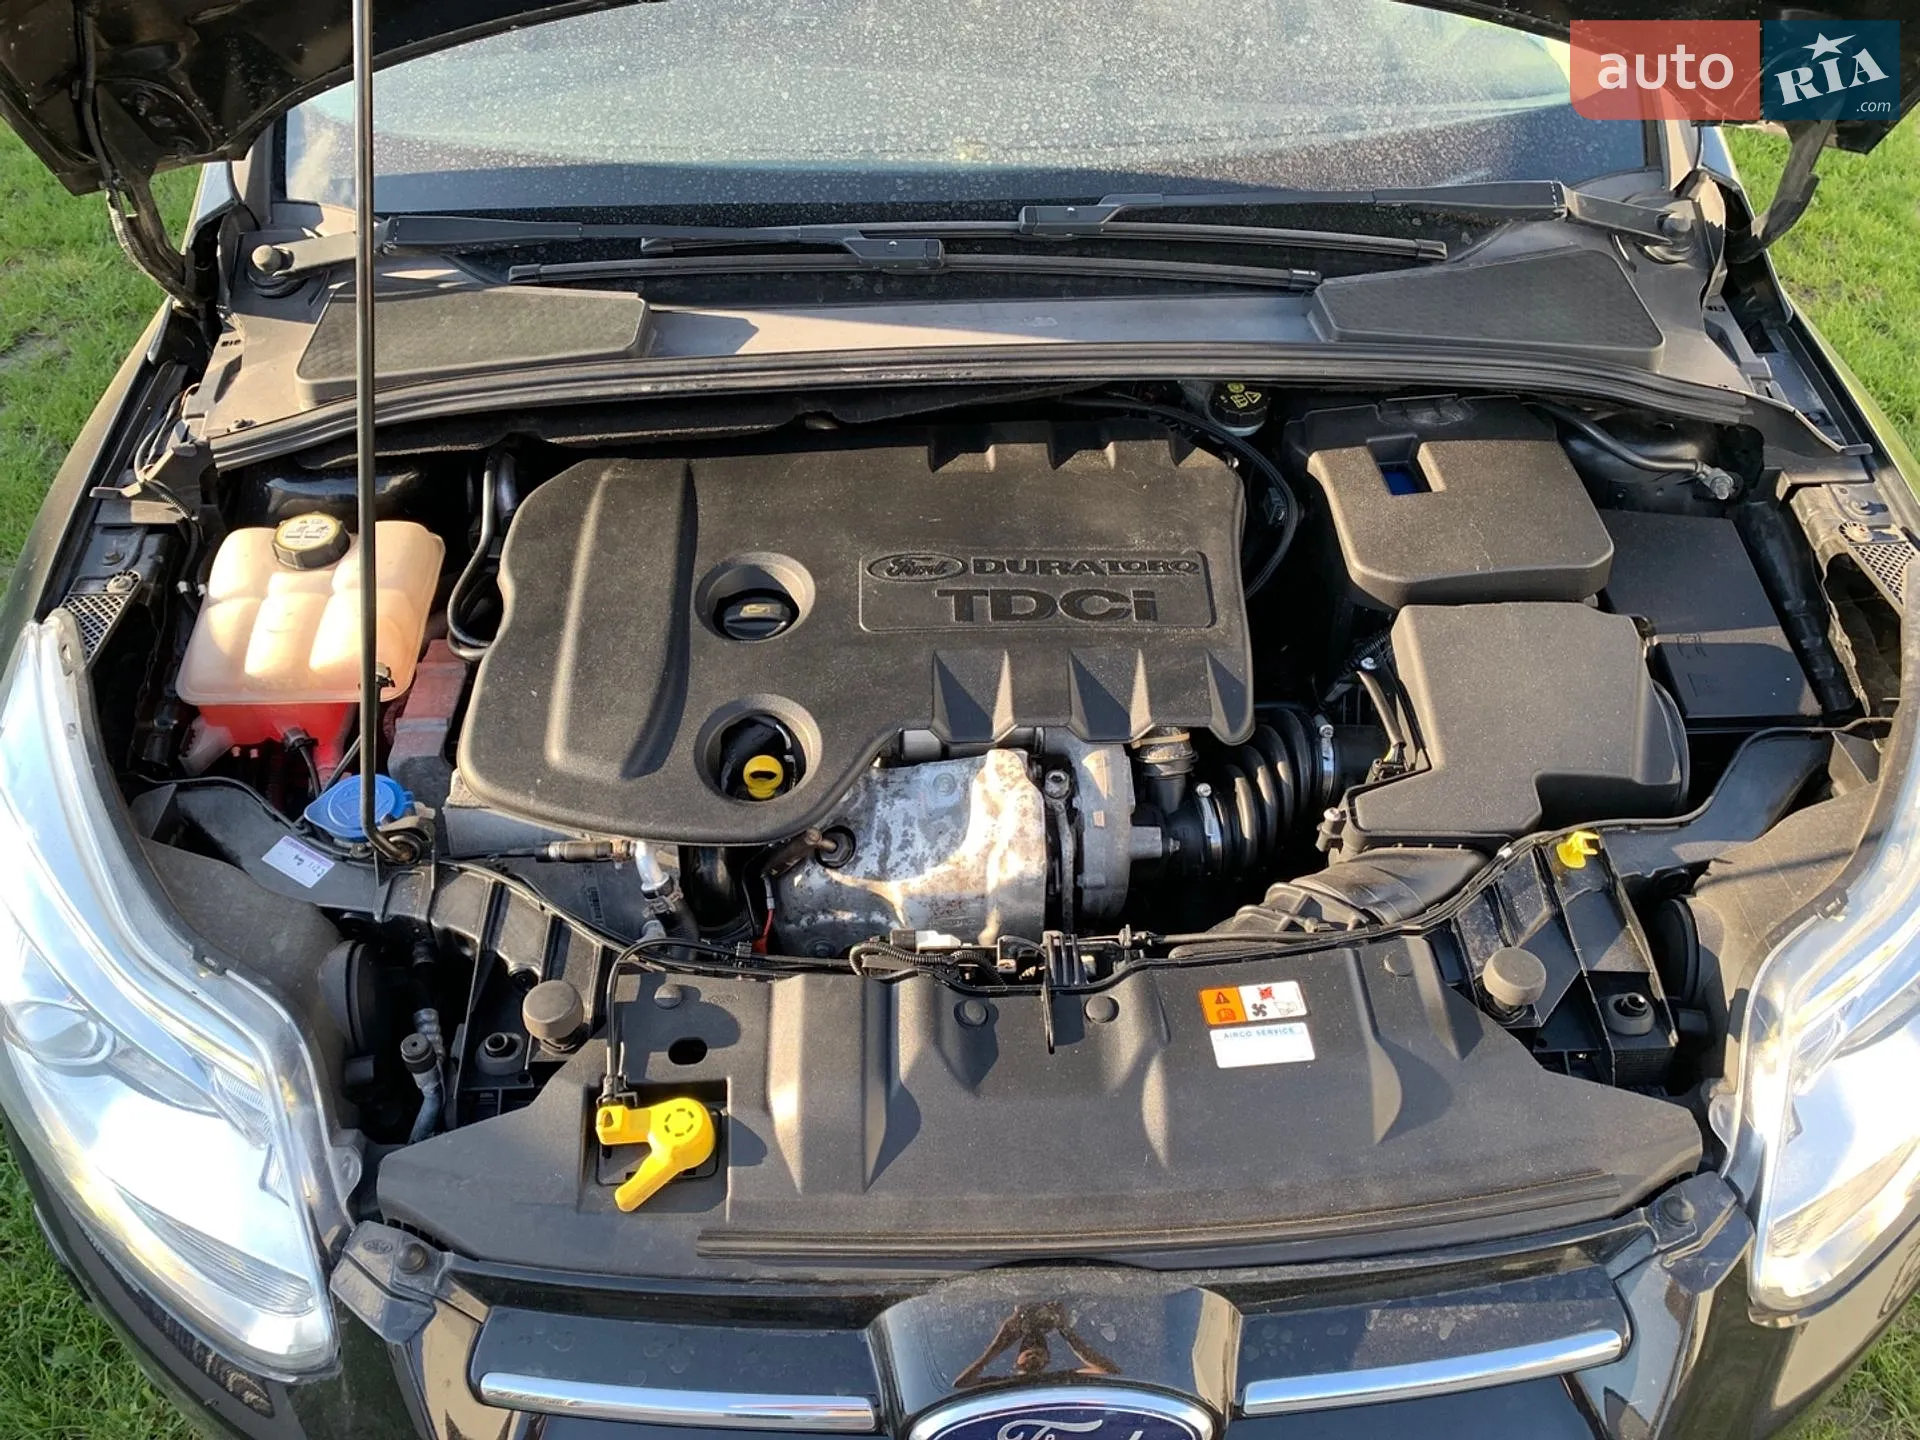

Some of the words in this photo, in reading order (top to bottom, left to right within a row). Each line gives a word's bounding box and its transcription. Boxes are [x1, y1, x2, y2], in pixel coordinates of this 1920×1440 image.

[971, 557, 1200, 576] DURATORQ
[935, 588, 1158, 622] TDCi
[1223, 1030, 1252, 1040] AIRCO
[1256, 1027, 1295, 1037] SERVICE
